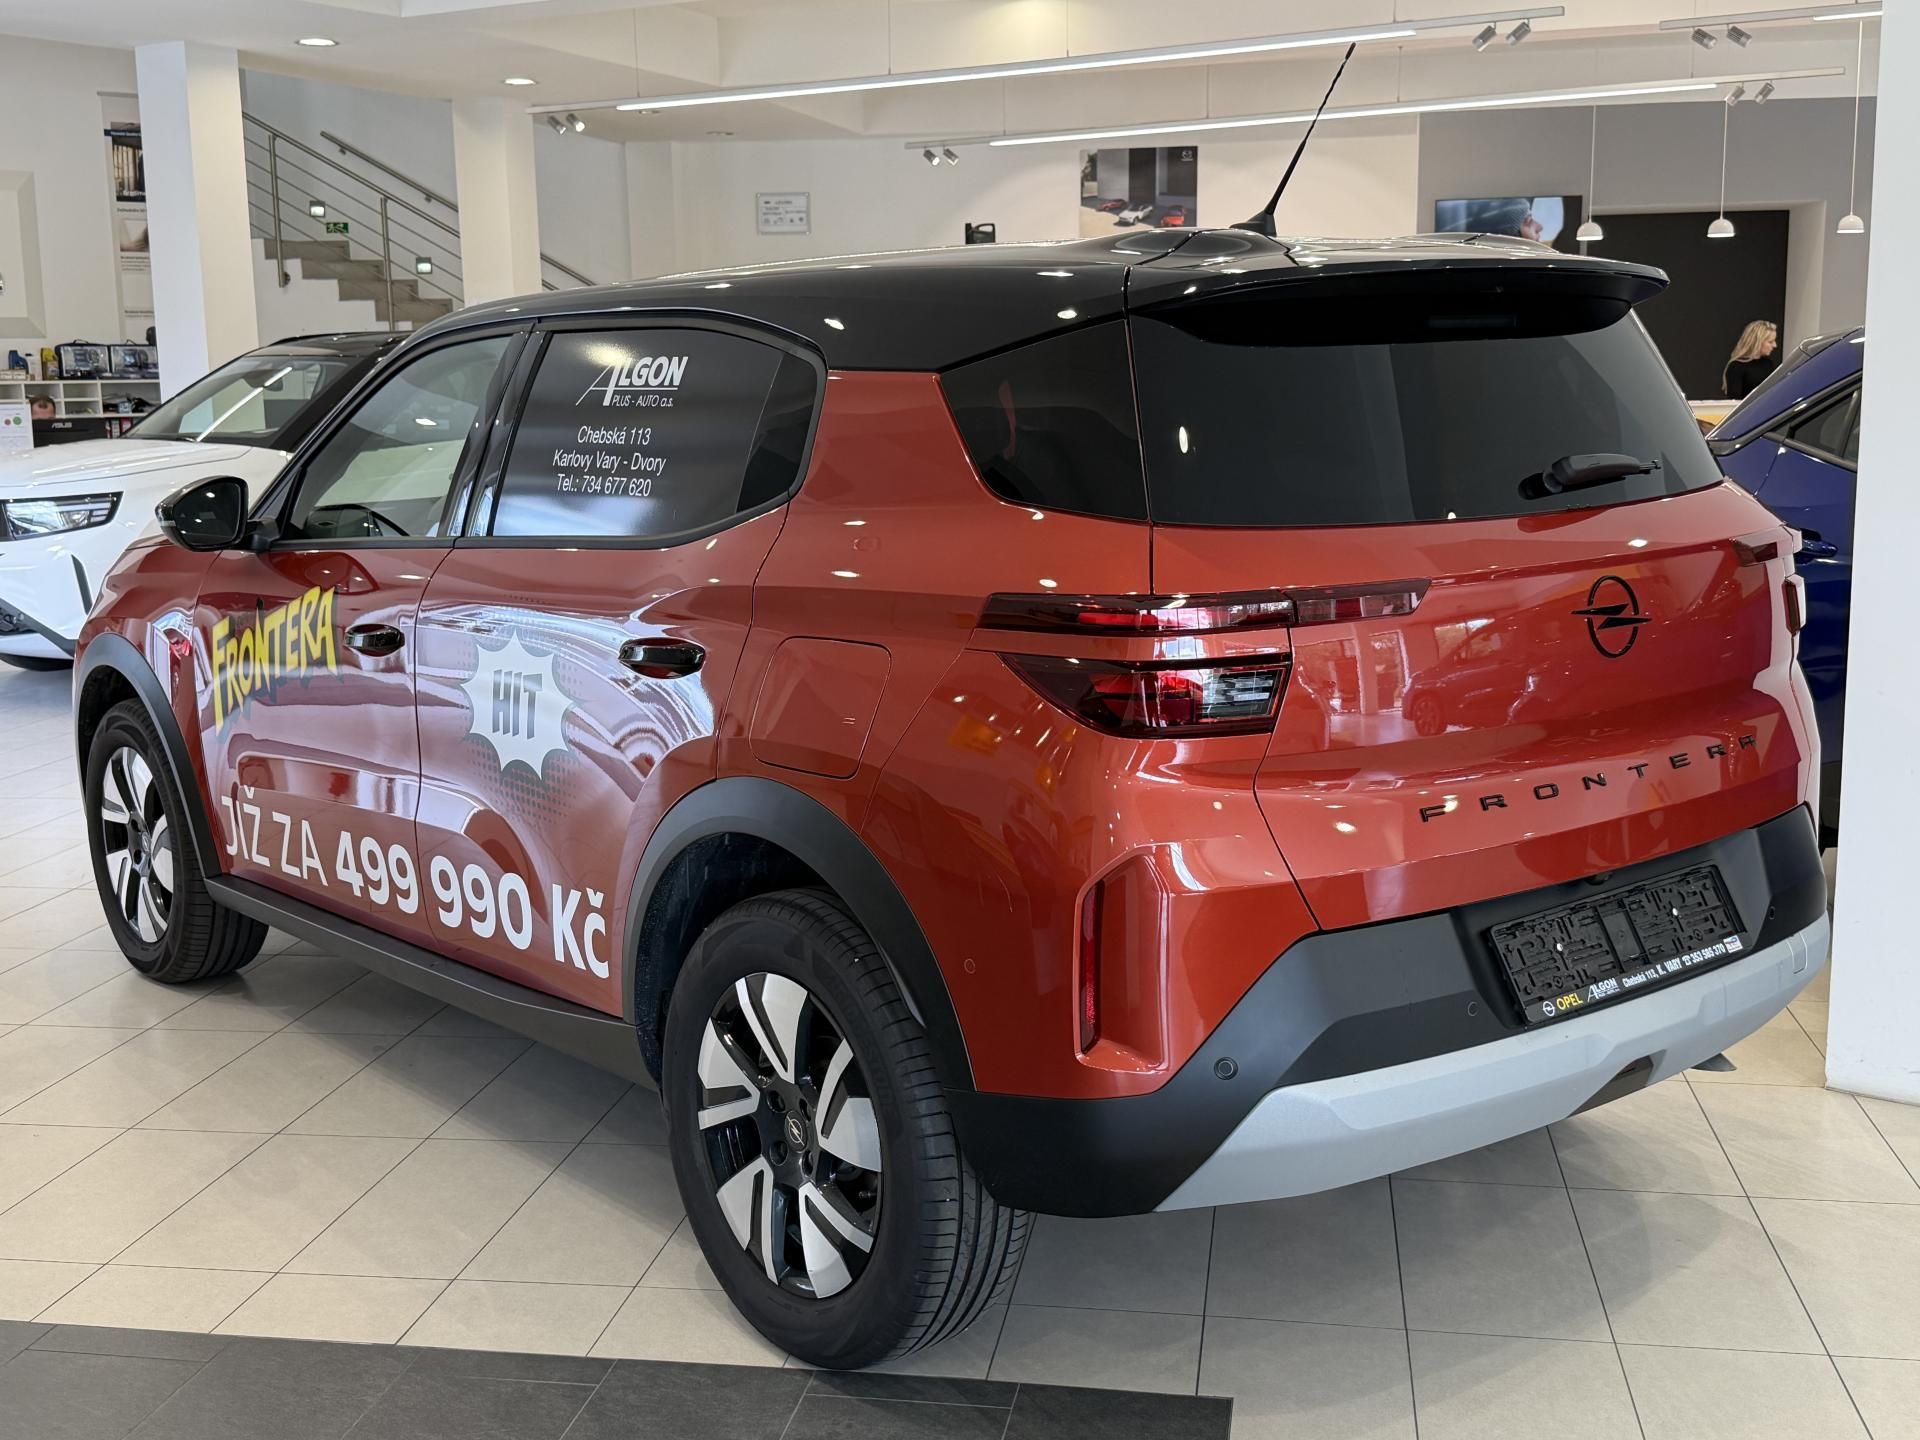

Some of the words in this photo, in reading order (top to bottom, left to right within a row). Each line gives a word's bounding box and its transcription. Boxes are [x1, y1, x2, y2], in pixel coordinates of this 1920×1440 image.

[576, 356, 689, 406] ALGON
[612, 395, 631, 407] PLUS
[636, 395, 660, 407] AUTO
[660, 398, 674, 407] a.s.
[577, 425, 626, 445] Chebská
[630, 427, 651, 445] 113
[552, 449, 594, 472] Karlovy
[596, 451, 622, 474] Vary
[630, 452, 667, 477] Dvory
[557, 473, 579, 493] Tel.:
[581, 475, 602, 493] 734
[604, 476, 626, 495] 677
[628, 478, 651, 496] 620
[212, 586, 338, 737] FRONTERA
[492, 669, 543, 740] HIT
[1419, 734, 1757, 823] FRONTERA
[221, 784, 271, 867] JIŽ
[272, 811, 329, 887] ZA
[335, 830, 419, 914] 499
[430, 855, 533, 950] 990
[552, 883, 610, 979] Kč
[1655, 963, 1667, 976] K.
[1663, 957, 1683, 973] VARY
[1712, 943, 1726, 955] 370
[1556, 992, 1584, 1010] OPEL
[1587, 977, 1619, 1003] ALGON
